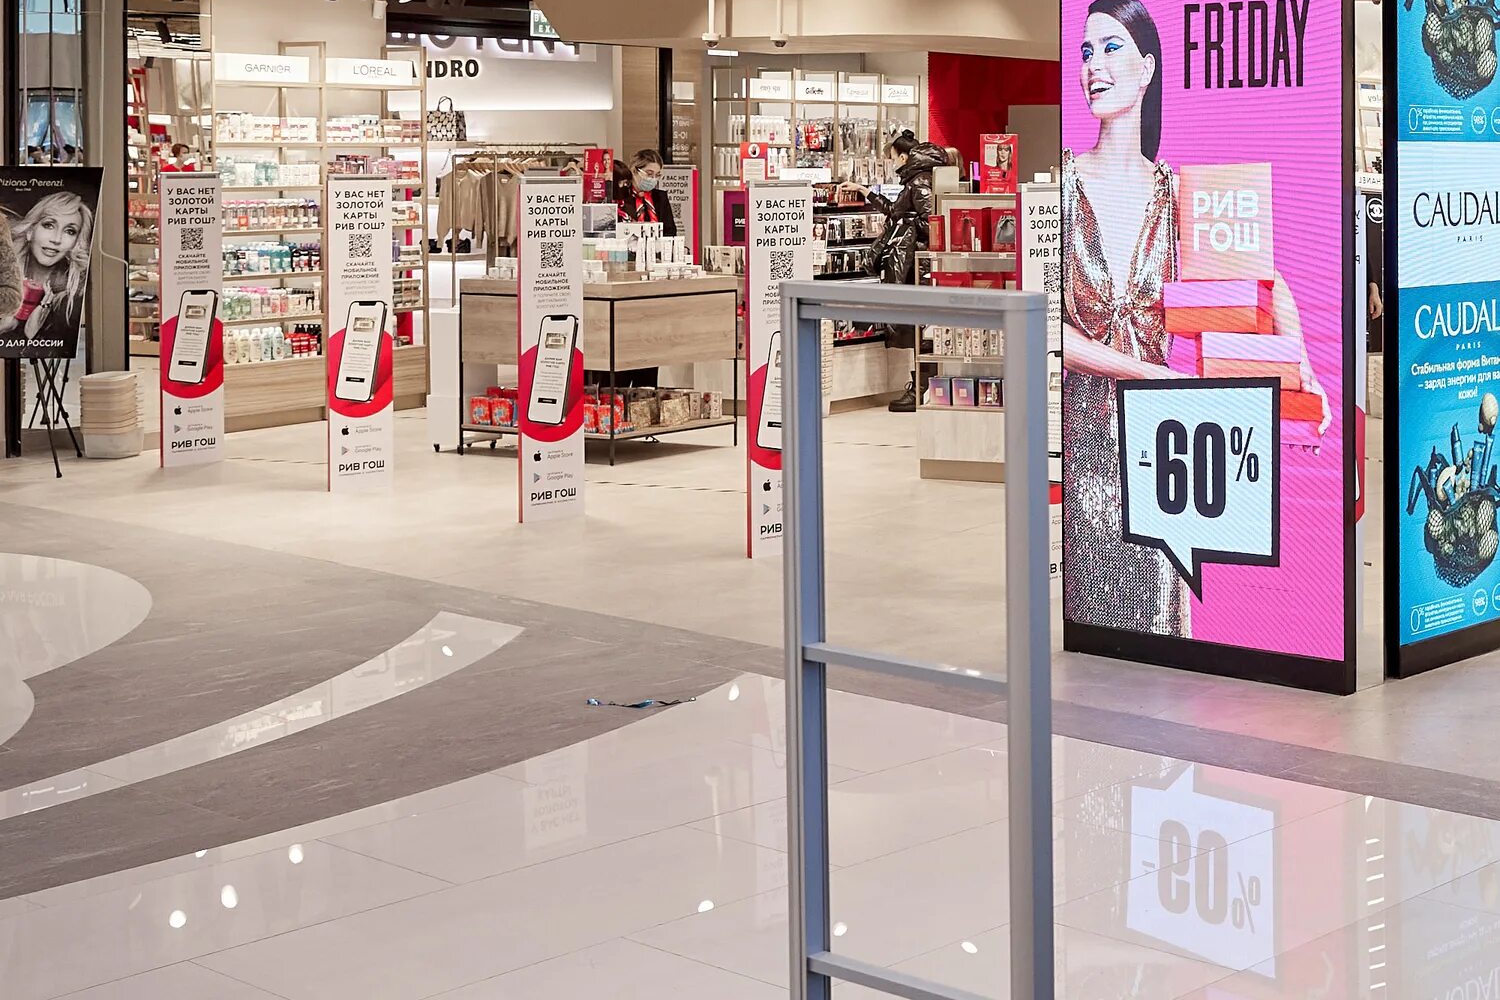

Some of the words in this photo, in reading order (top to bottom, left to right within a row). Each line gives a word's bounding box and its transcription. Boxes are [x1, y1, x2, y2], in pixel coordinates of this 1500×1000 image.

[245, 63, 291, 74] GARNIER
[0, 178, 28, 187] iziana
[176, 187, 196, 195] ВАС
[198, 187, 216, 195] НЕТ
[335, 191, 341, 199] У
[344, 190, 364, 198] ВАС
[367, 190, 385, 198] НЕТ
[168, 196, 214, 206] ЗОЛОТОЙ
[526, 195, 533, 203] У
[536, 195, 555, 203] ВАС
[557, 194, 576, 203] НЕТ
[336, 199, 384, 209] ЗОЛОТОЙ
[756, 200, 763, 209] У
[765, 199, 786, 209] ВАС
[788, 199, 806, 208] НЕТ
[1193, 189, 1260, 219] РИВ
[175, 207, 208, 215] КАРТЫ
[528, 205, 575, 215] ЗОЛОТОЙ
[1028, 205, 1035, 216] У
[1038, 205, 1059, 215] ВАС
[167, 217, 187, 225] РИВ
[189, 216, 216, 225] ГОШ?
[343, 212, 378, 220] КАРТЫ
[757, 210, 805, 222] ЗОЛОТОЙ
[335, 222, 355, 230] РИВ
[358, 222, 385, 230] ГОШ?
[535, 218, 568, 226] КАРТЫ
[1030, 219, 1061, 230] ЗОЛО
[527, 230, 547, 238] РИВ
[549, 229, 576, 238] ГОШ?
[764, 225, 799, 234] КАРТЫ
[756, 238, 776, 247] РИВ
[779, 237, 806, 246] ГОШ?
[1193, 222, 1260, 252] ГОШ
[1457, 235, 1484, 243] PARIS
[1029, 248, 1050, 258] РИВ
[6, 339, 25, 348] ДЛЯ
[27, 339, 64, 347] РОССИИ
[1455, 341, 1481, 351] PARIS
[1411, 359, 1455, 376] Стабильная
[1456, 357, 1480, 373] форма
[1424, 377, 1447, 391] заряд
[1447, 373, 1477, 389] энергии
[1477, 371, 1491, 384] для
[171, 439, 193, 450] РИВ
[194, 437, 216, 447] ГОШ
[338, 462, 360, 472] РИВ
[362, 459, 385, 470] ГОШ
[1138, 420, 1260, 518] -60%
[530, 490, 552, 501] РИВ
[554, 487, 577, 498] ГОШ
[760, 523, 782, 535] РИВ
